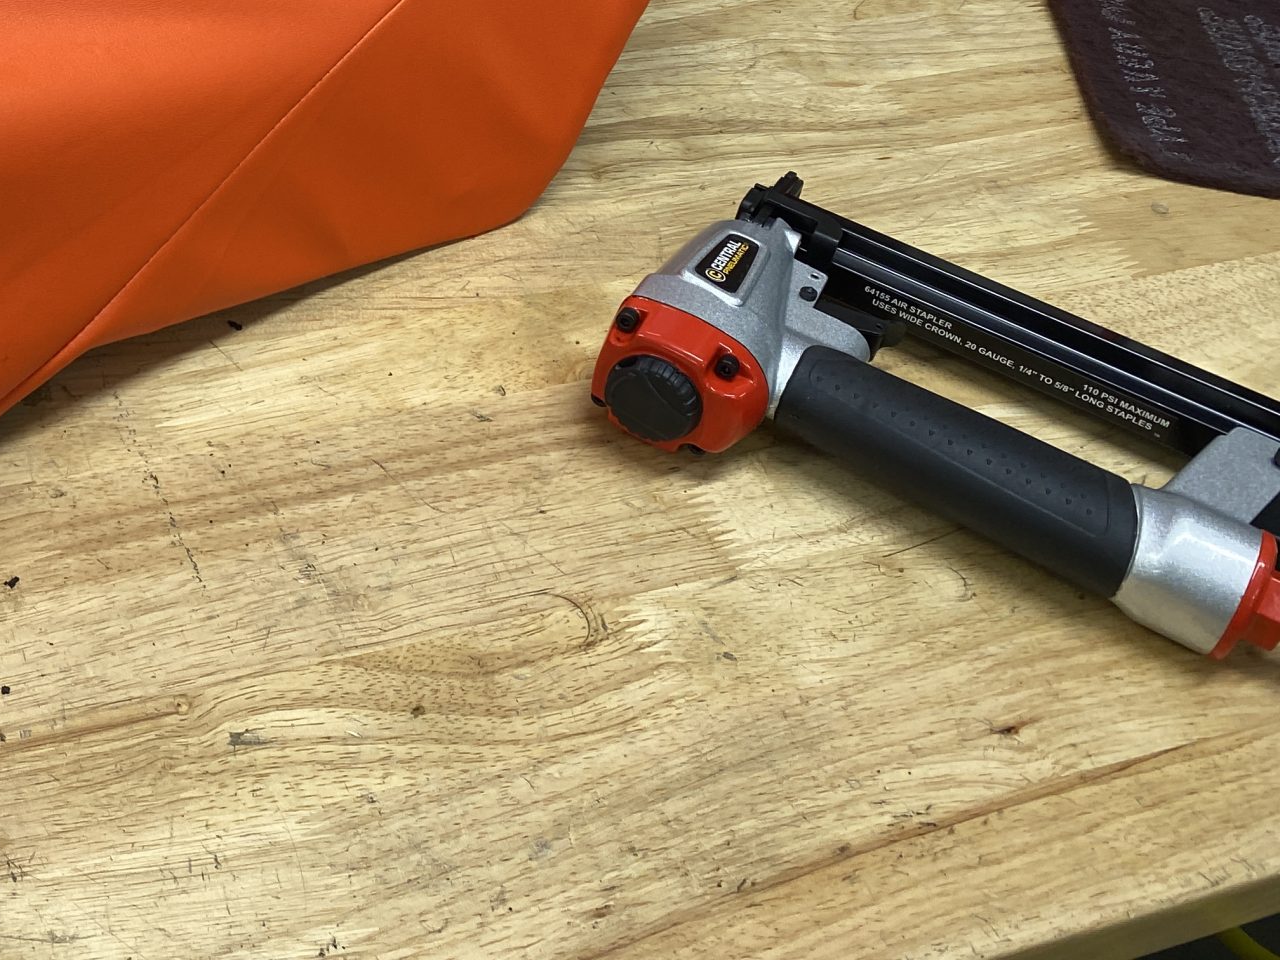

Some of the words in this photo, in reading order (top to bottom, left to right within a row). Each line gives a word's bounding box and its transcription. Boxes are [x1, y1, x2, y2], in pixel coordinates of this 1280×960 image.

[711, 240, 741, 271] CENTRAL
[864, 285, 890, 302] 64155
[891, 297, 908, 310] AIR
[909, 305, 953, 330] STAPLER
[872, 298, 897, 315] USES
[898, 310, 923, 326] WIDE
[964, 340, 977, 351] 20
[978, 347, 1016, 370] GAUGE,
[1039, 373, 1053, 385] TO
[1074, 390, 1104, 409] LONG
[1105, 405, 1153, 431] STAPLES
[1083, 384, 1100, 396] 110
[1101, 392, 1118, 405] PSI
[1119, 400, 1171, 429] MAXIMUM
